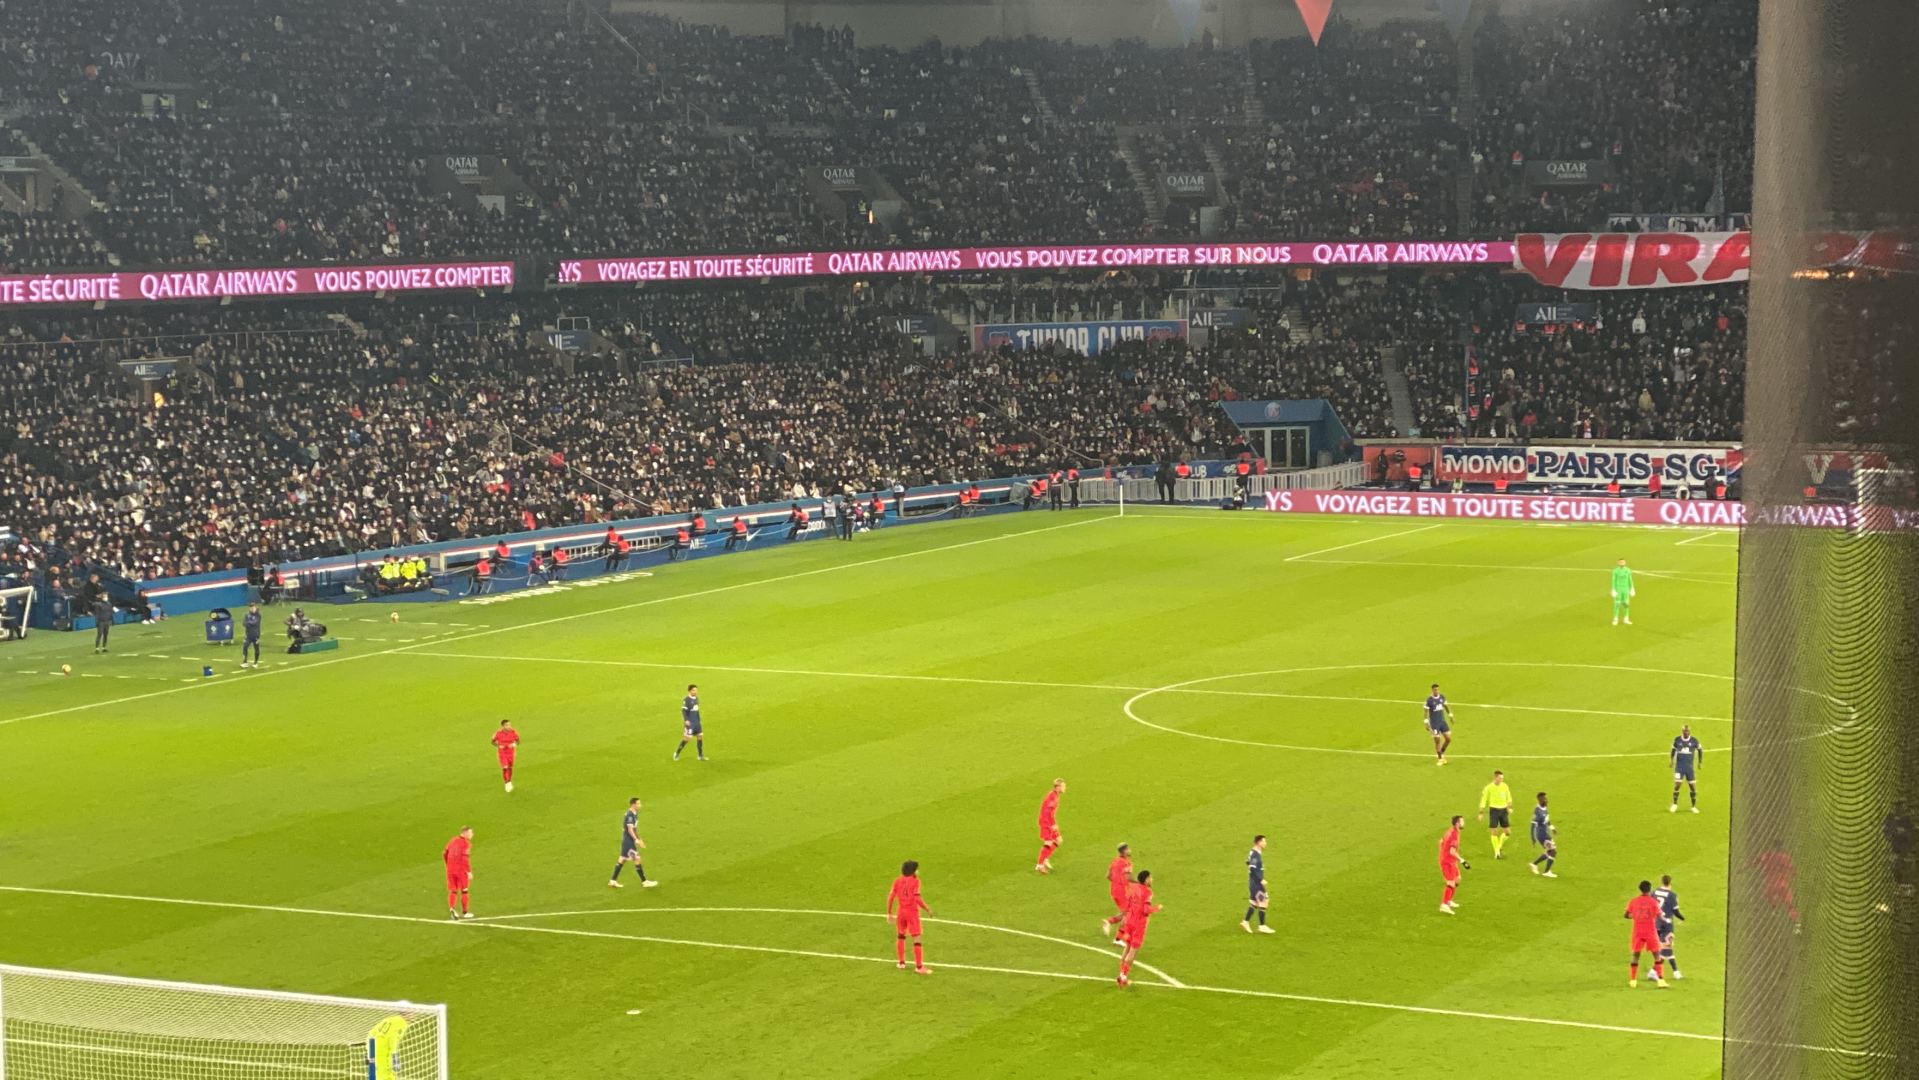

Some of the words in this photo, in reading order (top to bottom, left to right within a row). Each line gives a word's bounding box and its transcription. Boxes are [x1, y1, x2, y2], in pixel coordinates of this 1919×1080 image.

[446, 156, 478, 170] QATAR
[1546, 162, 1587, 175] QATAR
[823, 168, 855, 180] QATAR
[1167, 175, 1204, 187] QATAR
[558, 262, 582, 282] YS
[598, 261, 666, 281] VOYAGEZ
[670, 260, 690, 278] EN
[694, 258, 742, 277] TOUTE
[746, 253, 814, 275] SÉCURITÉ
[828, 252, 884, 275] QATAR
[888, 250, 961, 272] AIRWAYS
[976, 250, 1022, 268] VOUS
[1027, 248, 1098, 266] POUVEZ
[1101, 247, 1189, 266] COMPTER
[1195, 247, 1231, 264] SUR
[1236, 246, 1291, 264] NOUS
[1313, 243, 1389, 264] QATAR
[1393, 242, 1488, 263] AIRWAYS
[29, 273, 120, 300] SÉCURITÉ
[140, 273, 209, 299] QATAR
[213, 270, 297, 295] AIRWAYS
[314, 271, 361, 292] VOUS
[365, 269, 431, 289] POUVEZ
[435, 266, 511, 286] COMPTER
[1444, 454, 1526, 474] MOMO
[1535, 451, 1651, 480] PARIS
[1664, 453, 1720, 482] SG
[1265, 491, 1292, 511] YS
[1315, 494, 1410, 515] VOYAGEZ
[1418, 497, 1446, 515] EN
[1452, 498, 1524, 517] TOUTE
[1530, 496, 1635, 522] SÉCURITÉ
[1660, 501, 1747, 526] QATAR
